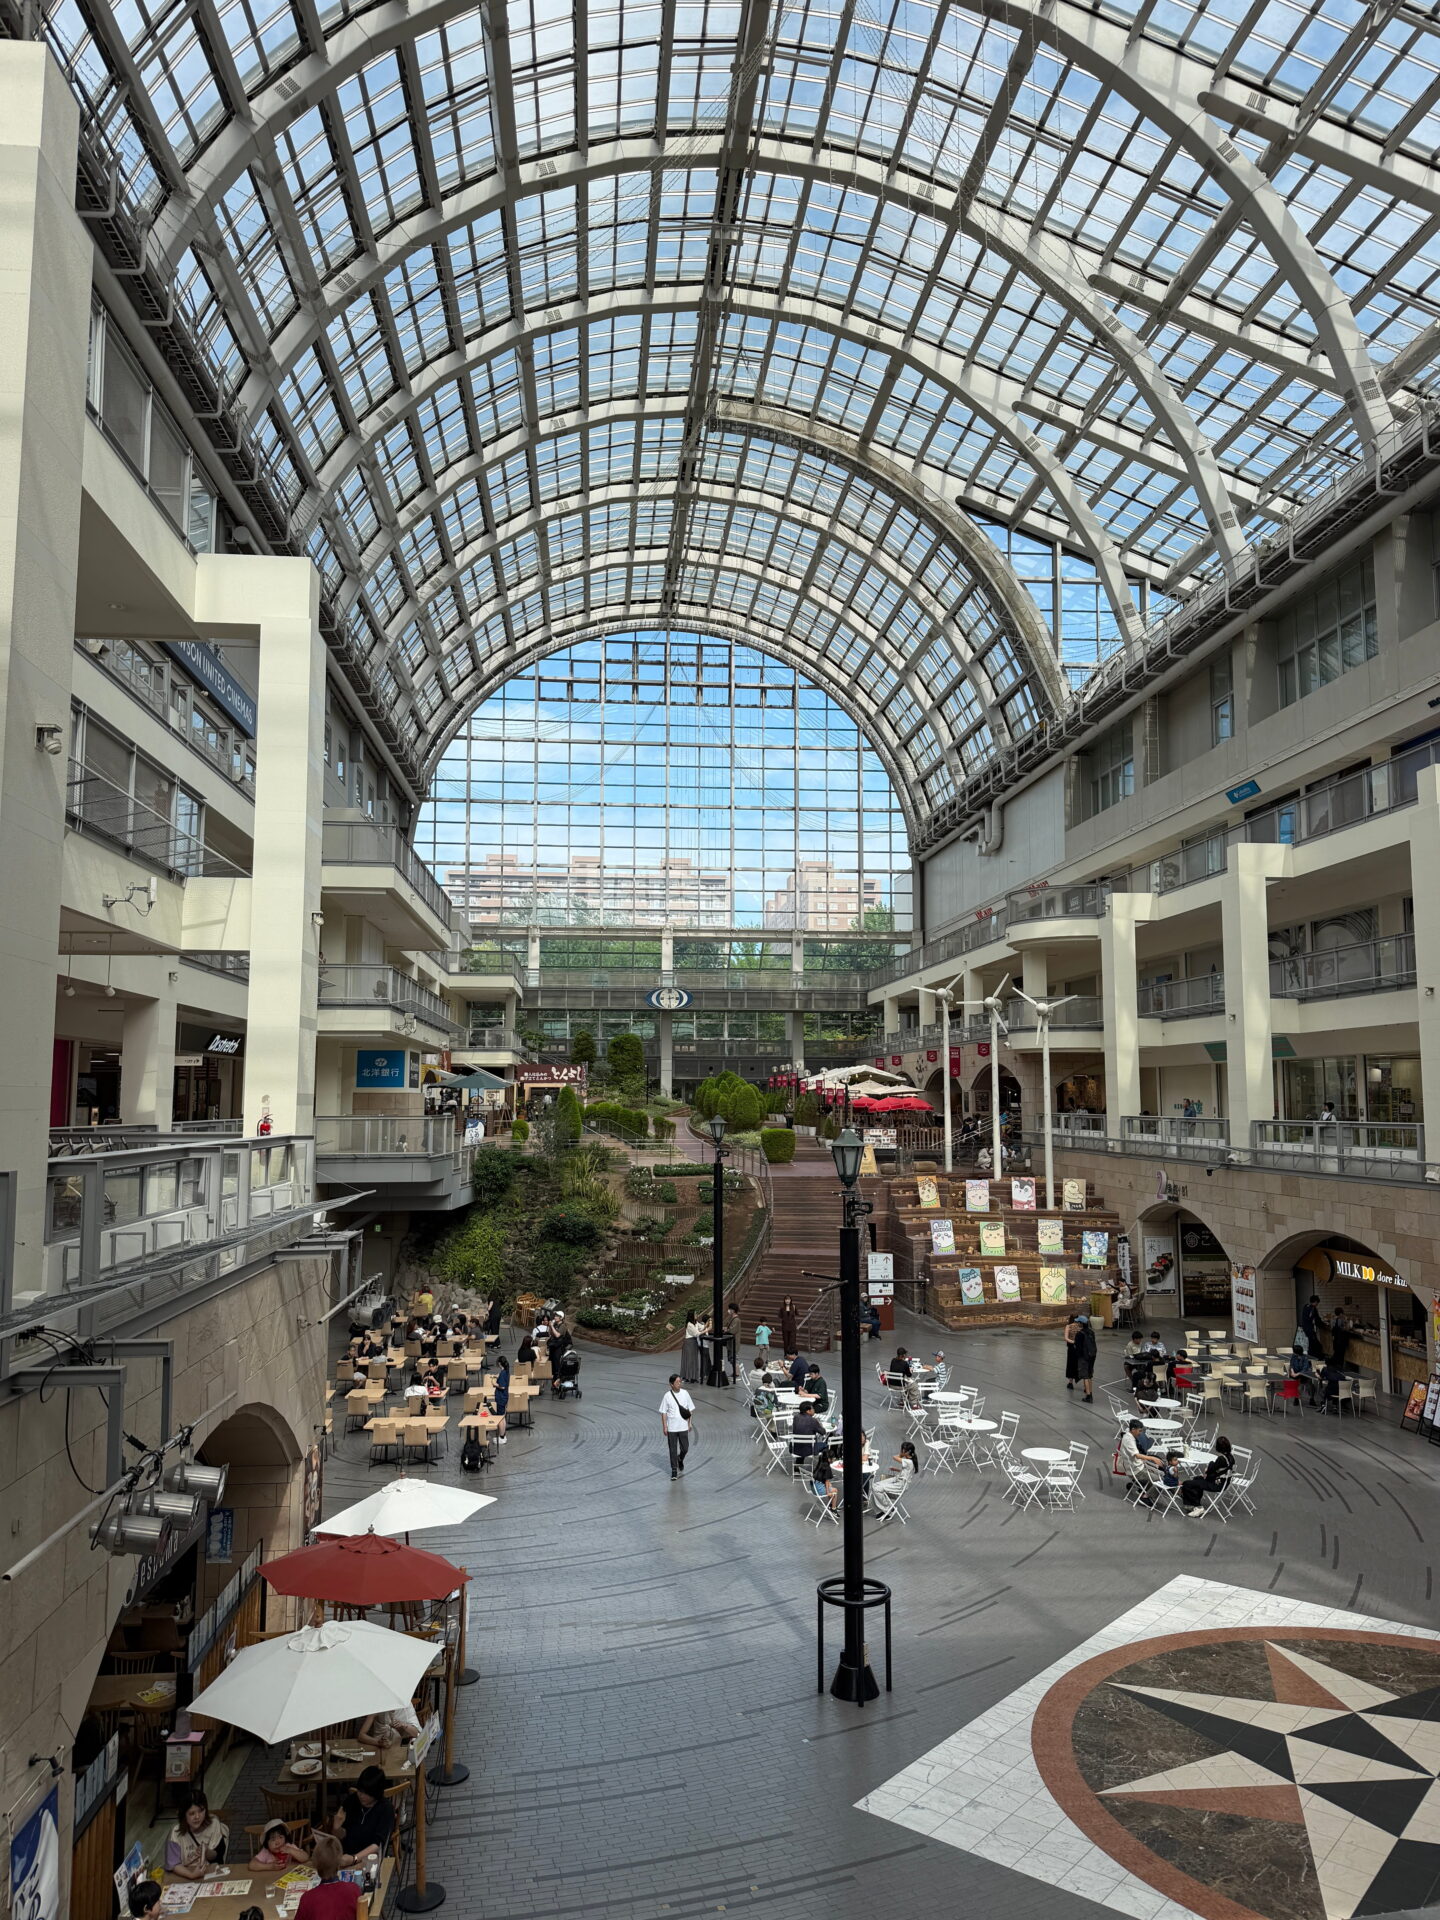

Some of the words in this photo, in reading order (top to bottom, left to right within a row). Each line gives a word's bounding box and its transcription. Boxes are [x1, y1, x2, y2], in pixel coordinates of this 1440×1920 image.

[202, 655, 226, 694] UNITED
[226, 684, 253, 725] CINEMAS
[361, 1067, 400, 1077] 北洋銀行
[551, 1066, 582, 1081] とんよし
[1336, 1260, 1361, 1279] MILK
[1361, 1265, 1375, 1281] DO
[1376, 1270, 1393, 1284] dore
